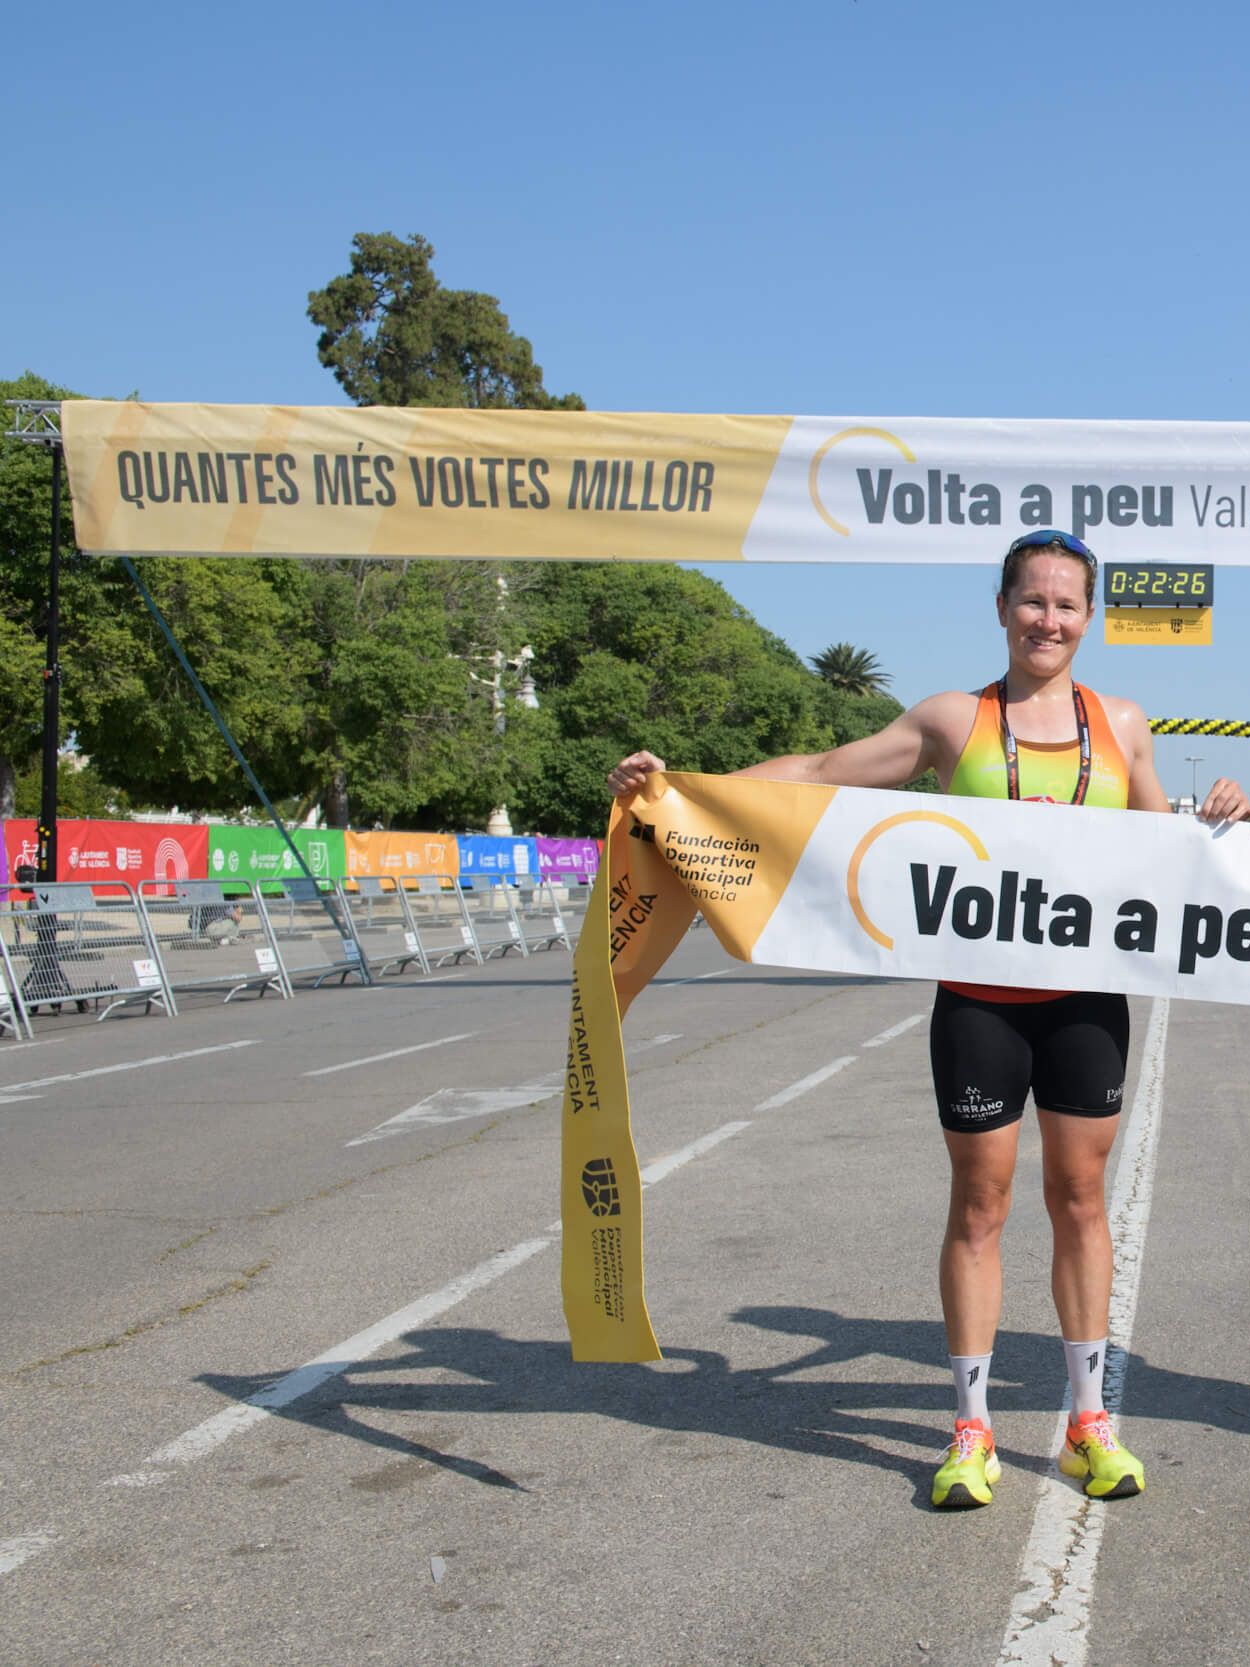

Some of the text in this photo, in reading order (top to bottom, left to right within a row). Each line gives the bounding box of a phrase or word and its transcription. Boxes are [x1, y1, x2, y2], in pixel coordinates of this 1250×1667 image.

[117, 441, 715, 512] QUANTES MÉS VOLTES MILLOR
[856, 468, 1001, 525] Volta
[1019, 483, 1053, 526] a
[1072, 484, 1173, 540] peu
[1111, 571, 1206, 594] 0:22:26
[666, 831, 760, 853] Fundación
[666, 848, 756, 870] Deportiva
[687, 883, 737, 902] lència
[910, 863, 1093, 948] Volta
[1114, 898, 1158, 953] a
[572, 970, 601, 1111] NTAMENT
[599, 1228, 615, 1317] Municipal
